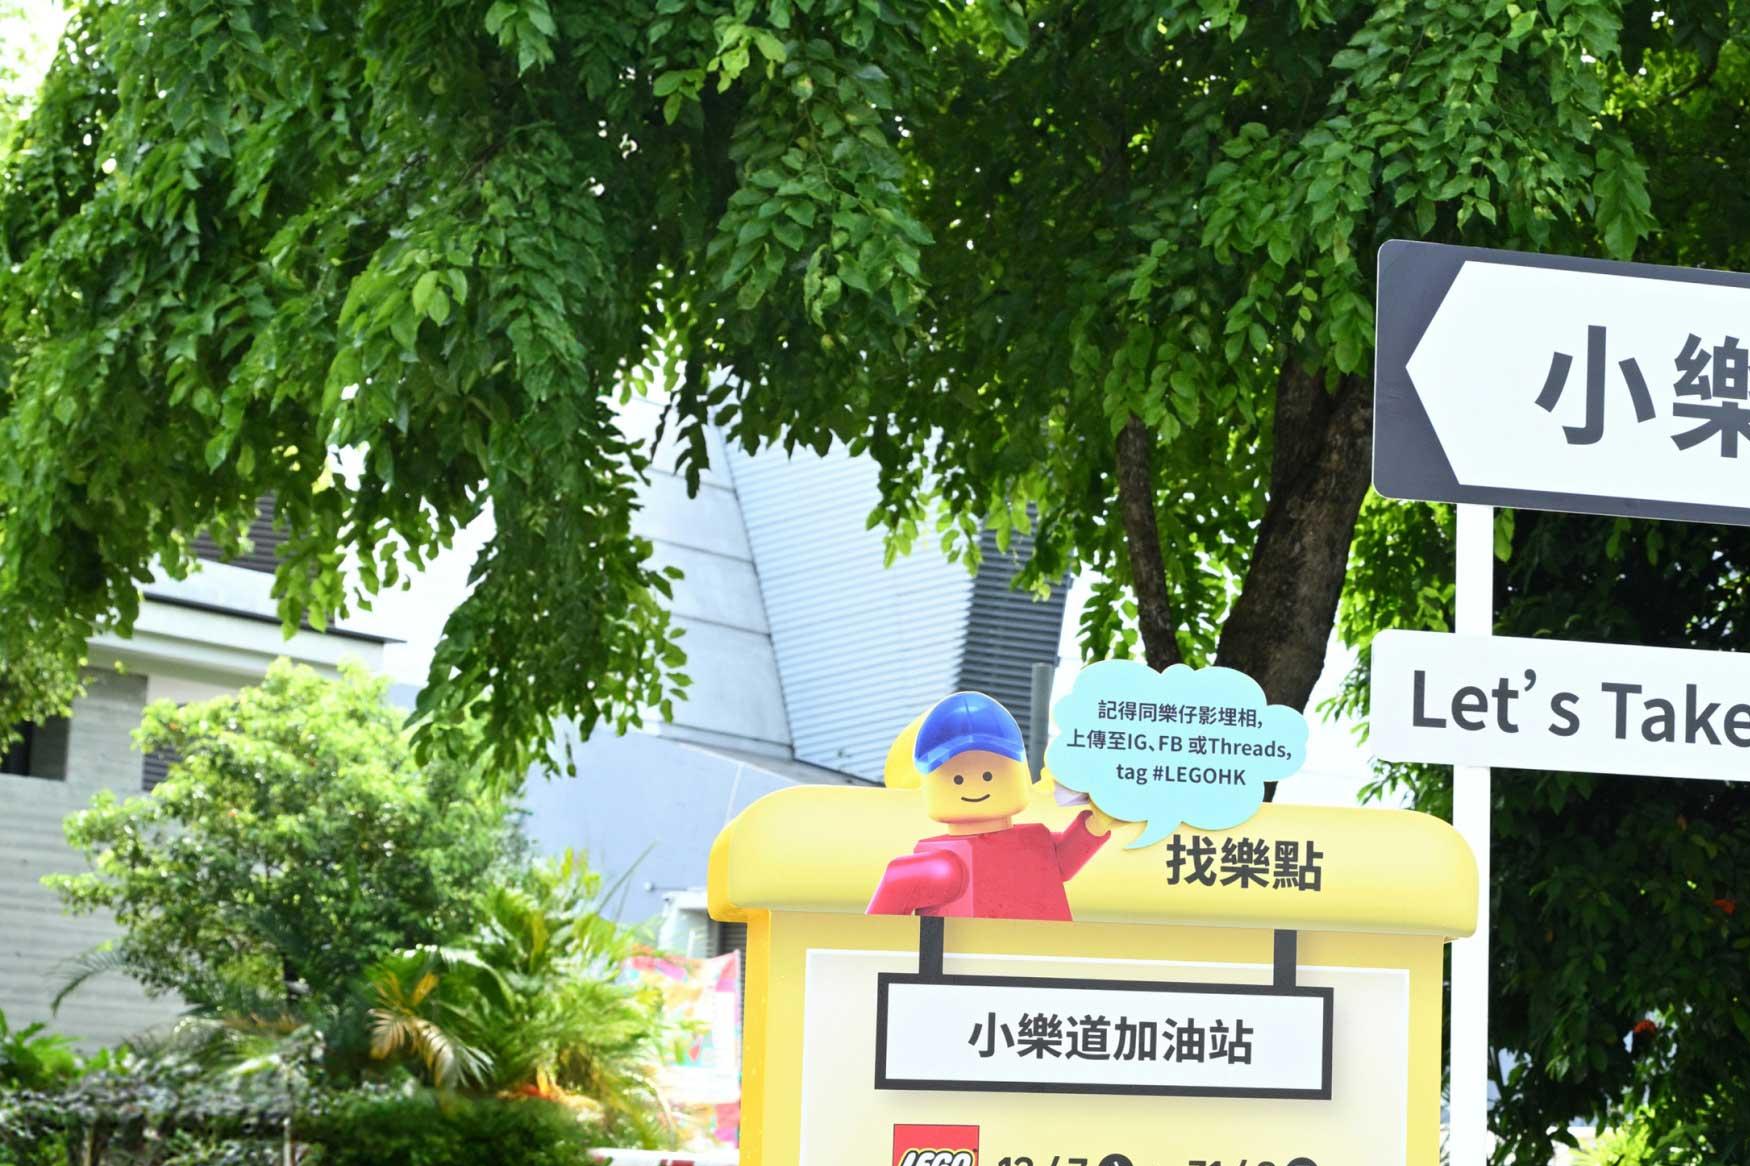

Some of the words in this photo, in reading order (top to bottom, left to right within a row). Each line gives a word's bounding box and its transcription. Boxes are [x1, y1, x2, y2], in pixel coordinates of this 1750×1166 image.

[1098, 699, 1264, 729] 記得同樂仔影埋相,
[1411, 668, 1581, 738] Let’s
[1187, 735, 1293, 761] 或Threads,
[1116, 763, 1148, 785] tag
[1152, 765, 1247, 786] #LEGOHK
[1165, 833, 1325, 893] 找樂點
[967, 1010, 1255, 1065] 小樂道加油站
